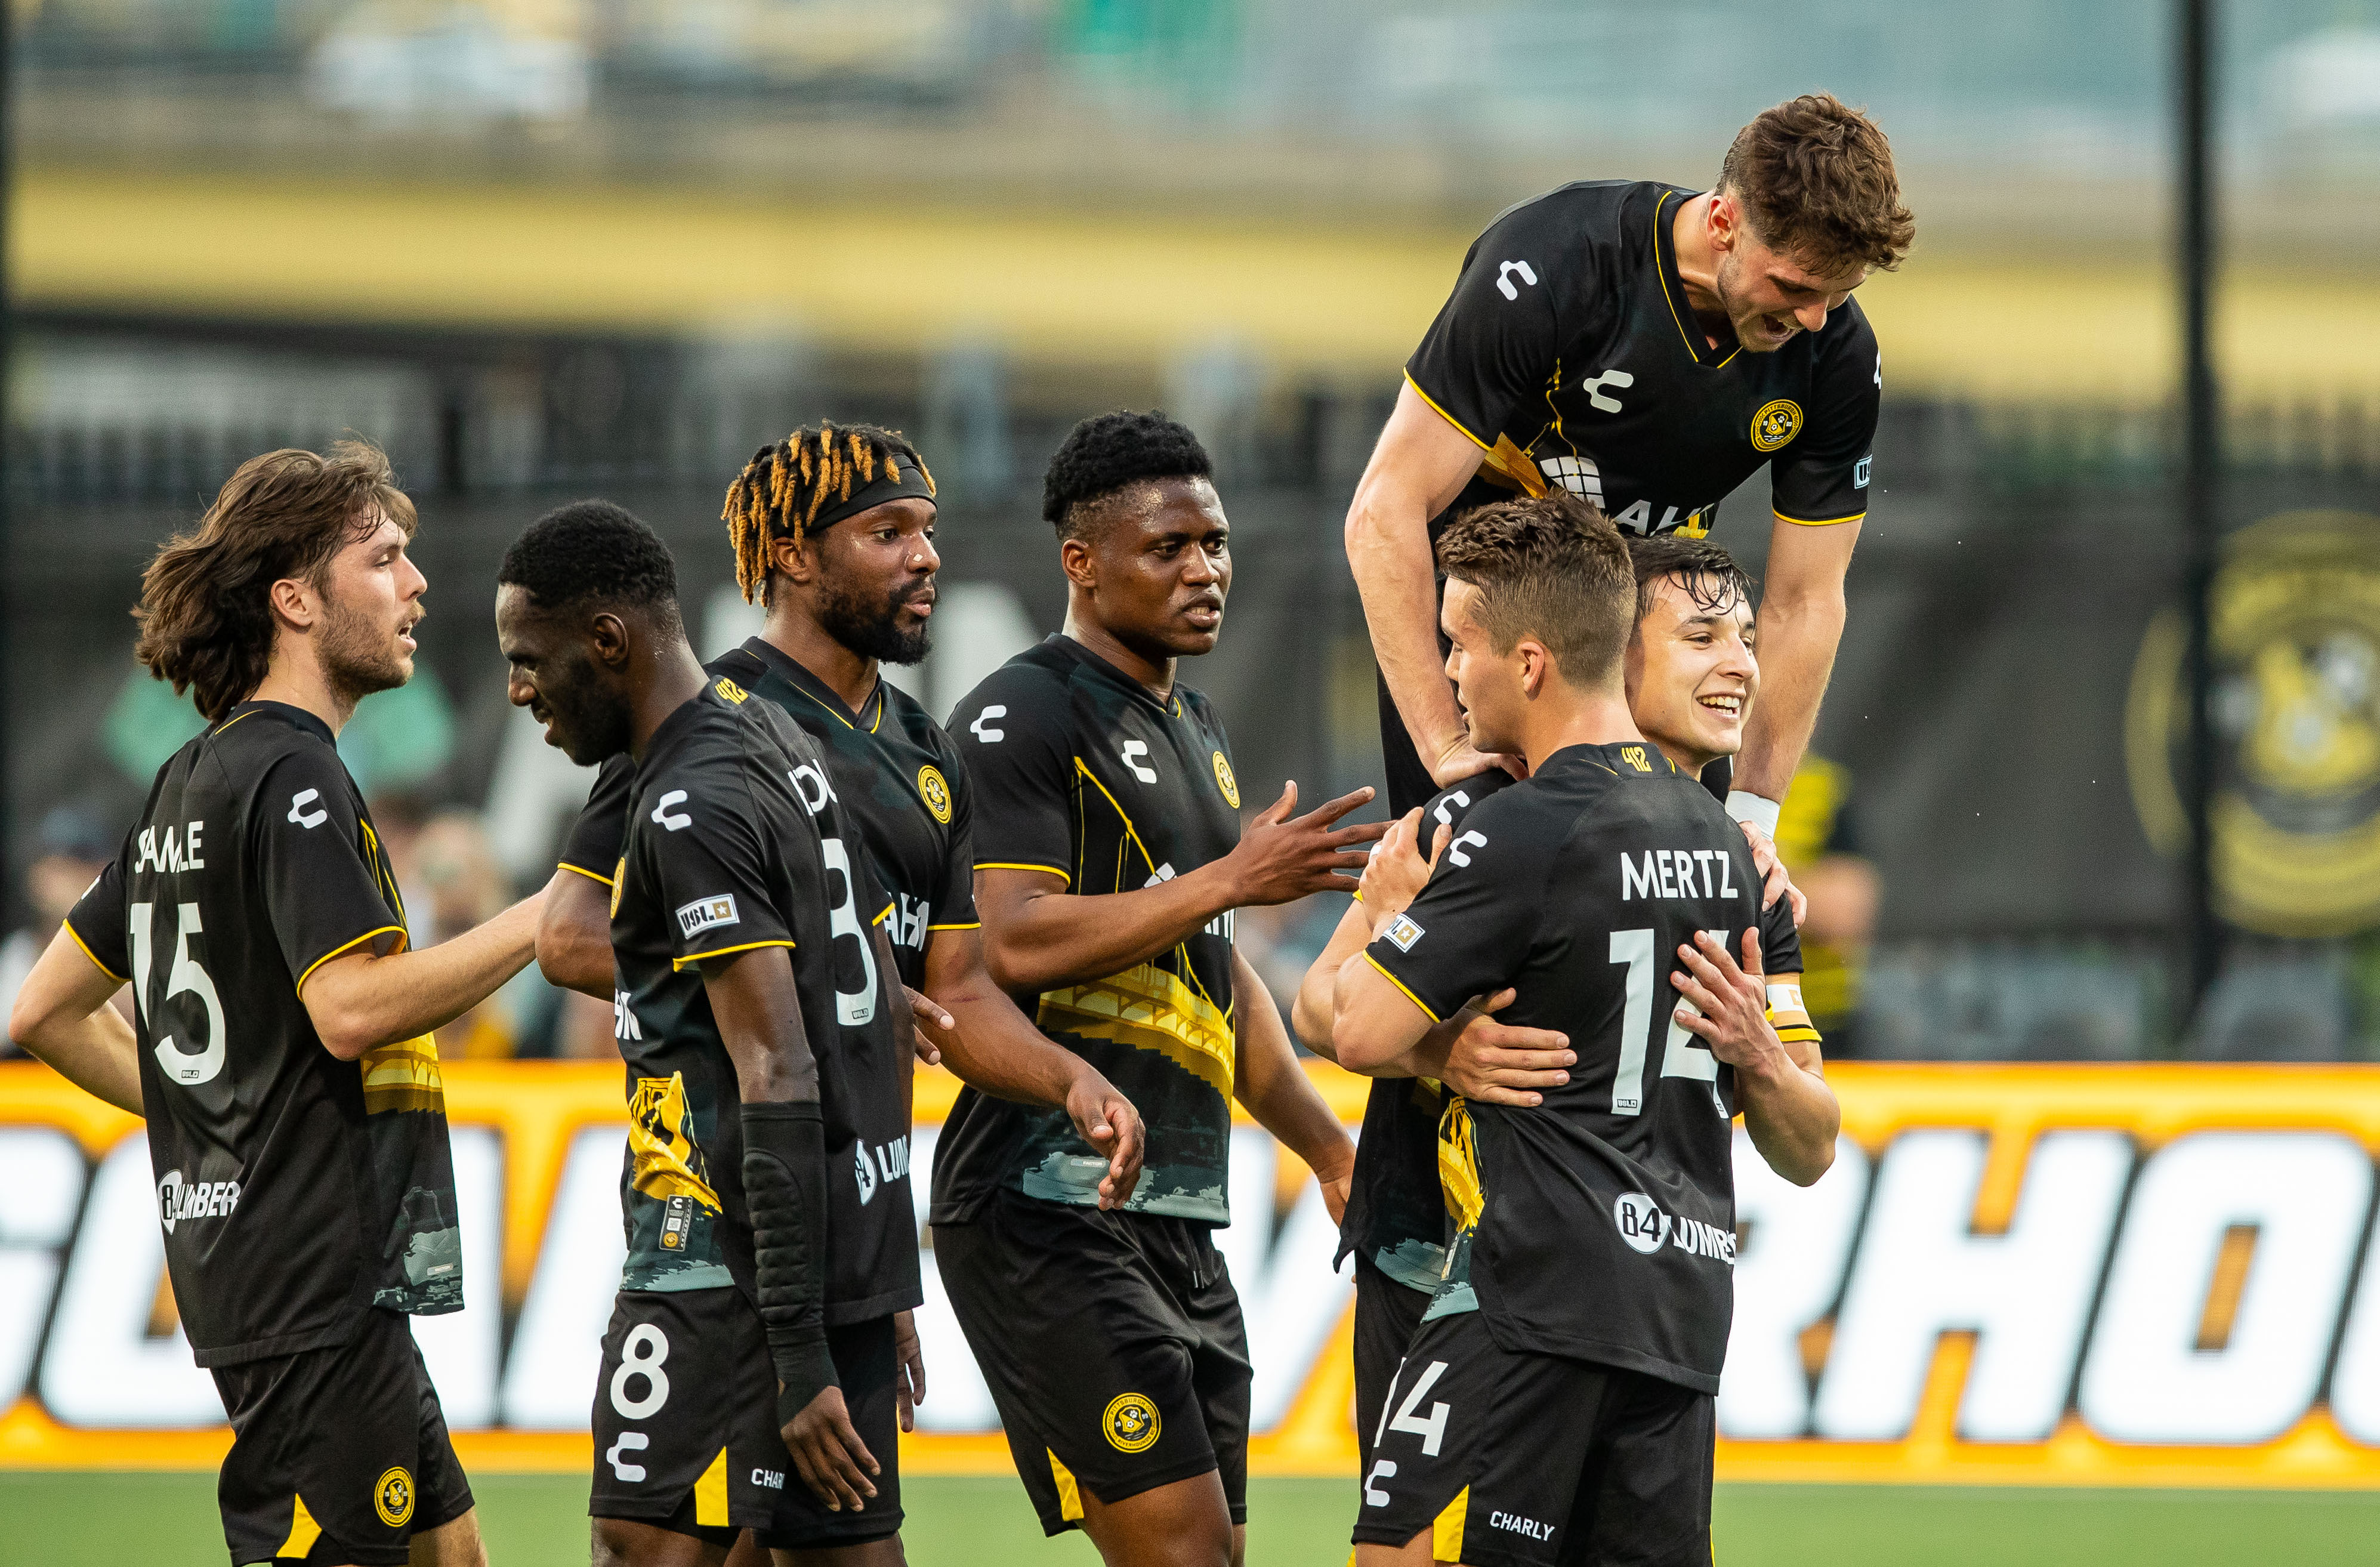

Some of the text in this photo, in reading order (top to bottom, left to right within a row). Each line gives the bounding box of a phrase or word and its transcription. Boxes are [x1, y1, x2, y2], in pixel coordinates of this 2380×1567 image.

[715, 678, 749, 705] 412
[1621, 746, 1653, 772] 412
[1620, 850, 1739, 901] MERTZ
[129, 902, 226, 1085] 15
[1609, 928, 1730, 1119] 14
[1622, 1201, 1662, 1242] 84
[610, 1323, 669, 1419] 8
[1373, 1356, 1451, 1457] 14
[1490, 1510, 1555, 1541] CHARLY
